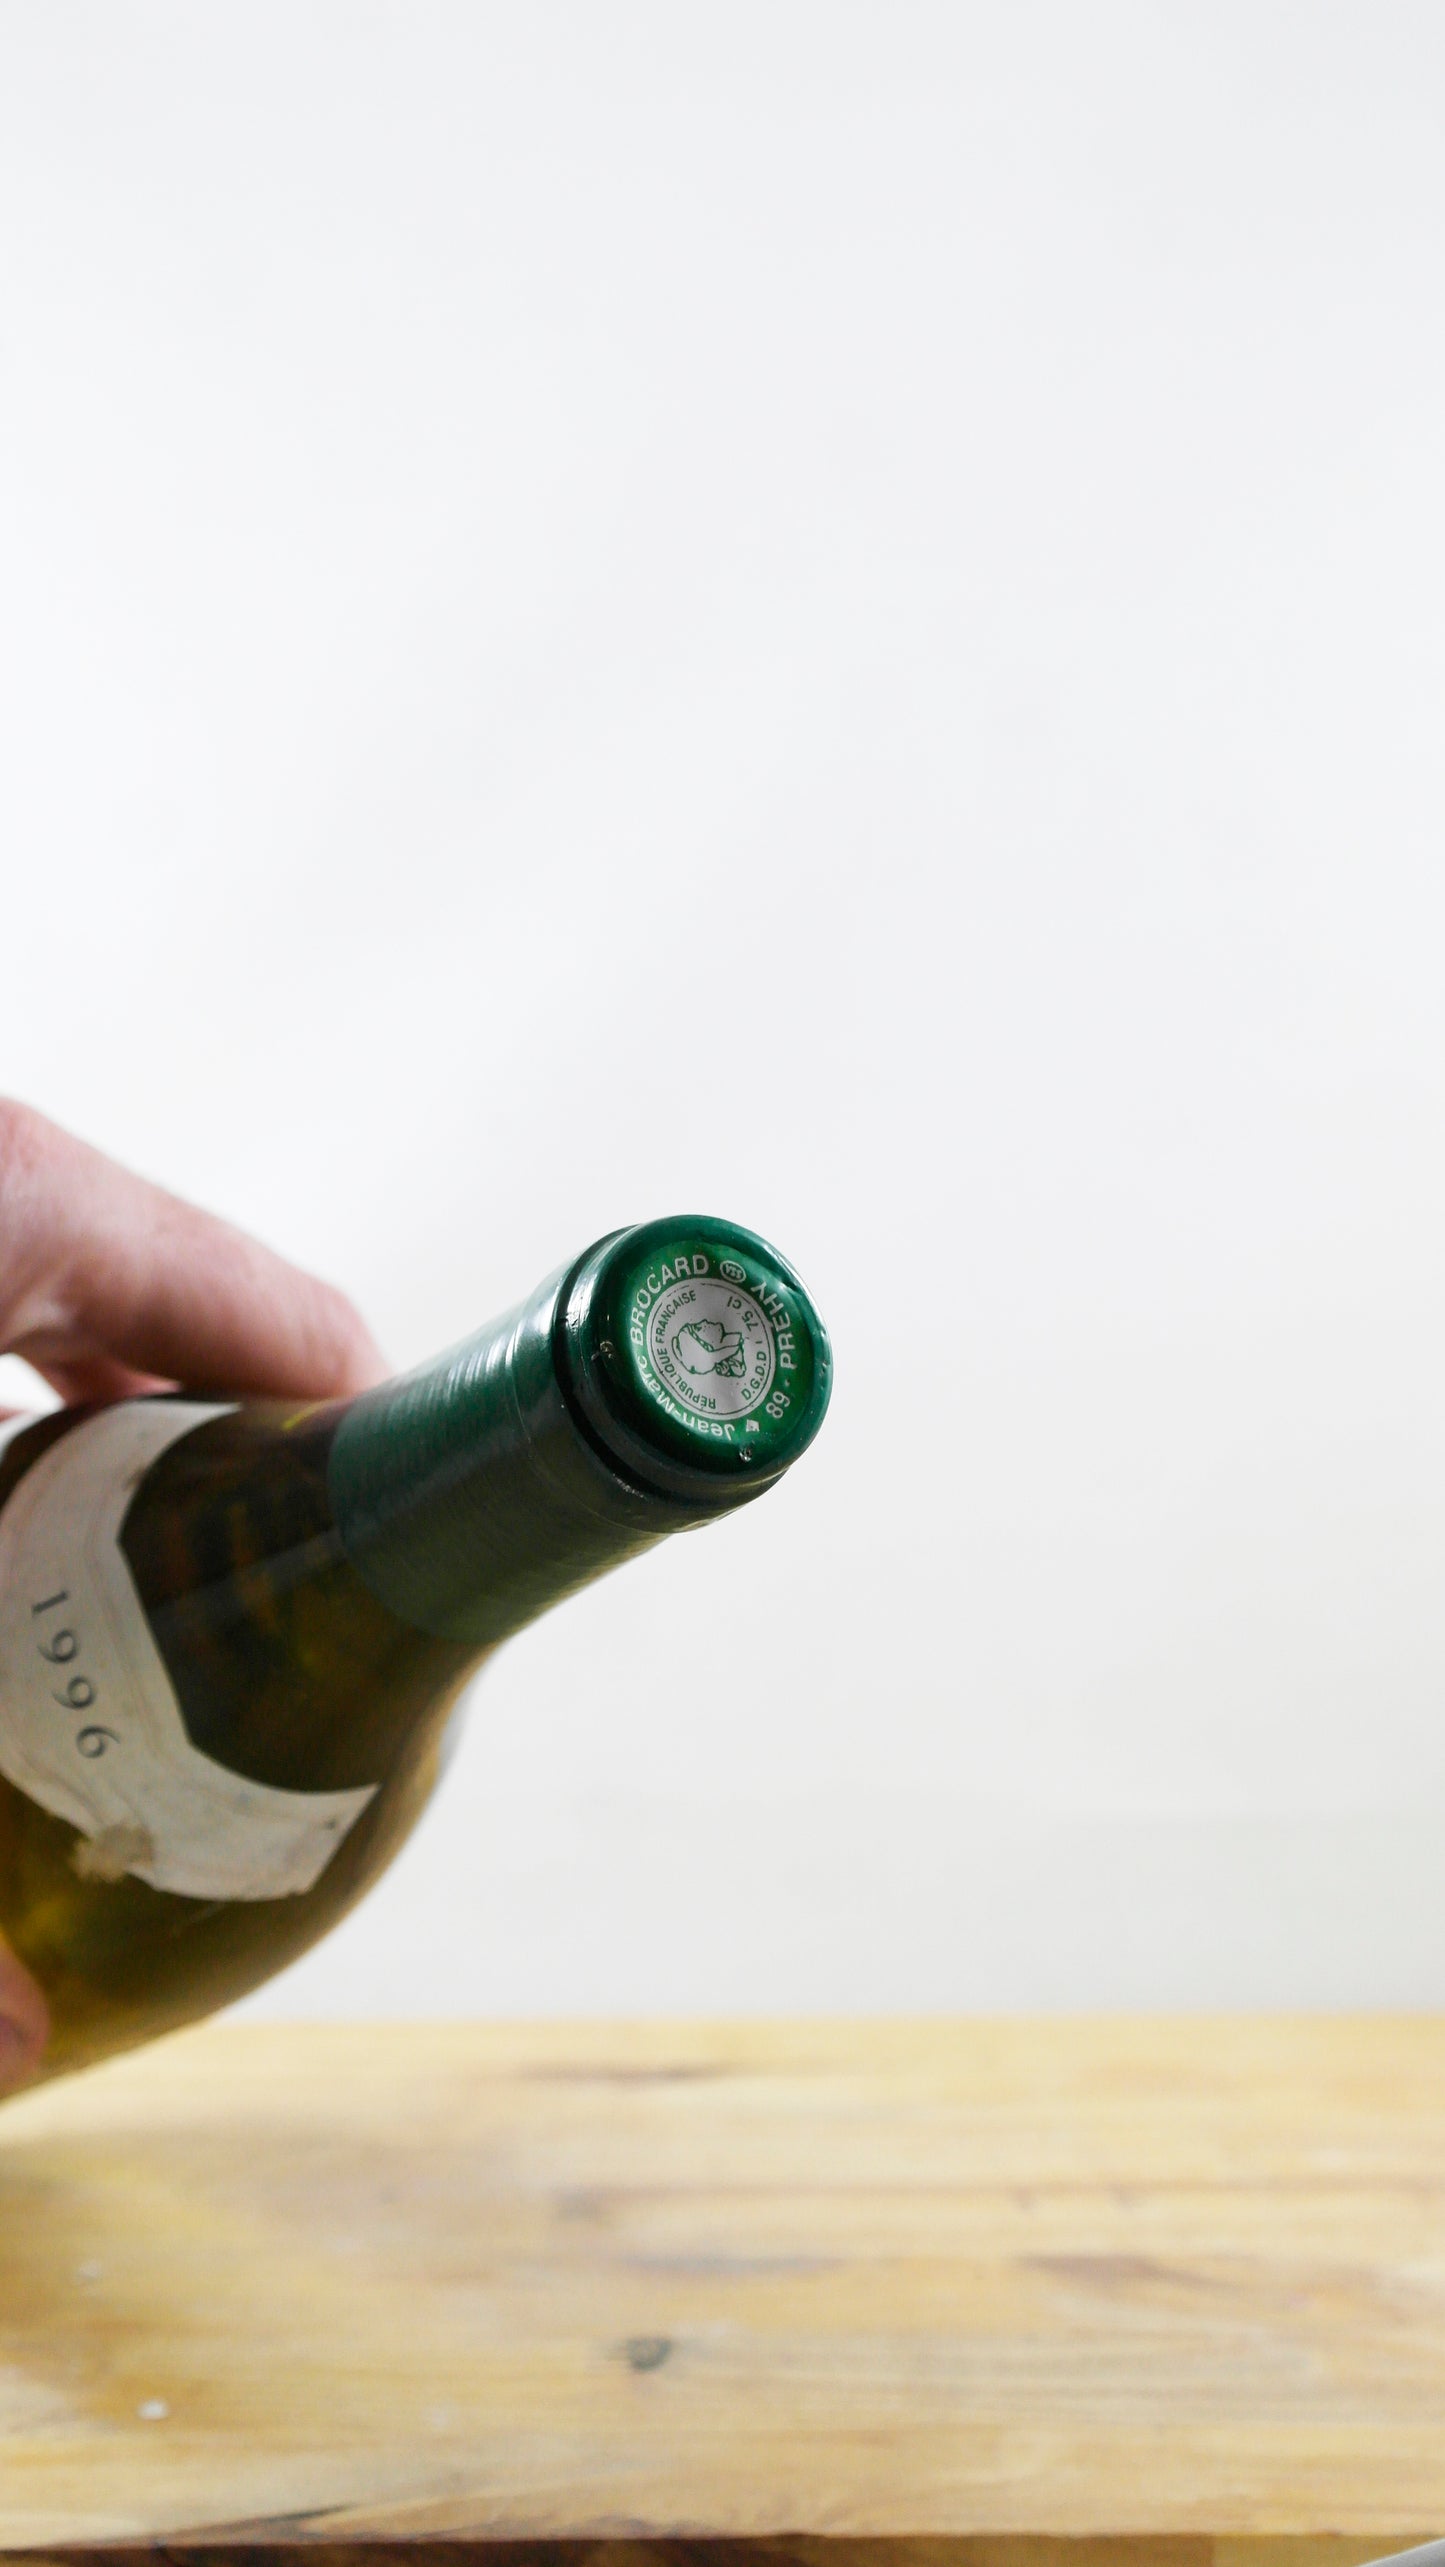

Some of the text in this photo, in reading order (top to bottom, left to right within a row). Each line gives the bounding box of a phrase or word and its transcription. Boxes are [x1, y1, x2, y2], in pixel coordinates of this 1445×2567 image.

[630, 1254, 735, 1441] Jean-Marc BROCARD
[655, 1290, 716, 1410] RÉPUBLIQUE FRANÇAISE
[741, 1311, 759, 1332] 75
[750, 1282, 797, 1419] 89 PREHY
[32, 1589, 121, 1759] 1996
